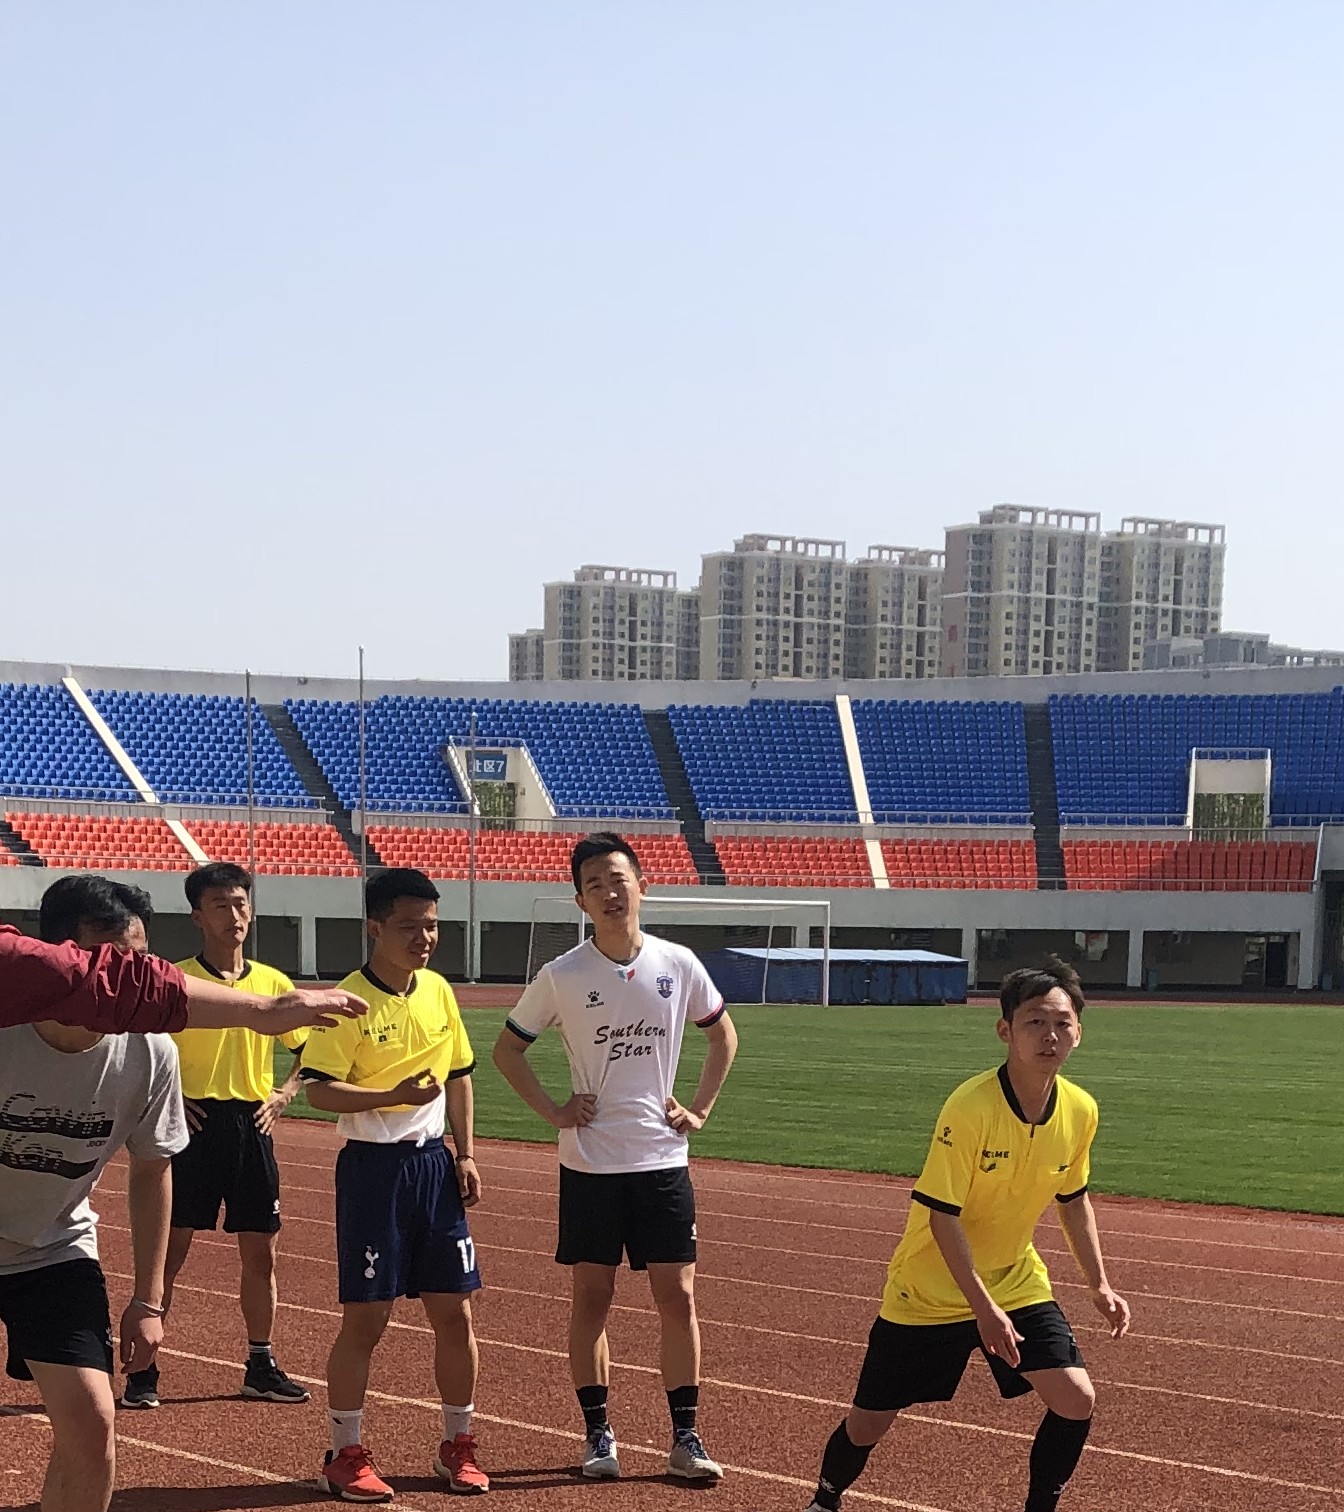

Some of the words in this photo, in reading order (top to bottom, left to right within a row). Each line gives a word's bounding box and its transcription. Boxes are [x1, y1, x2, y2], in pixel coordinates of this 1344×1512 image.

[468, 759, 505, 773] 北区7
[363, 1023, 397, 1036] KELME
[594, 1019, 666, 1044] Southern
[609, 1042, 653, 1061] Star
[457, 1236, 475, 1273] 17
